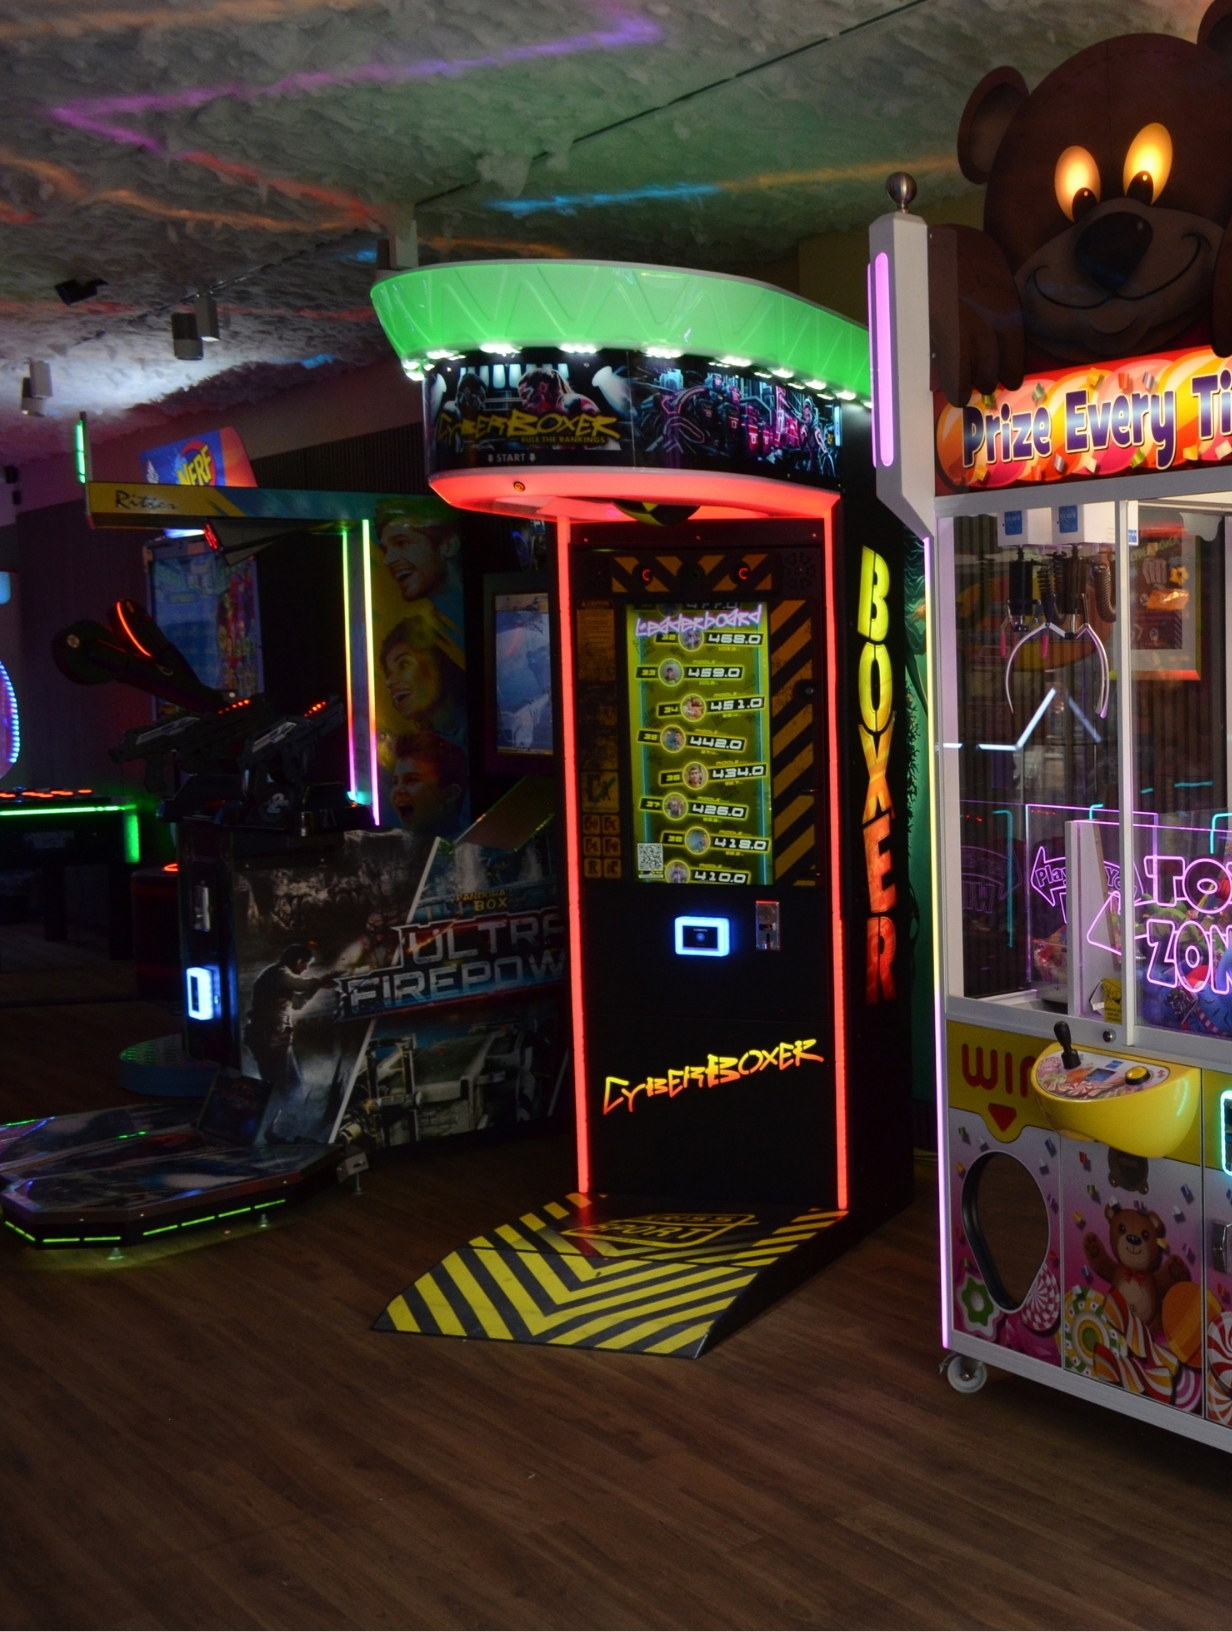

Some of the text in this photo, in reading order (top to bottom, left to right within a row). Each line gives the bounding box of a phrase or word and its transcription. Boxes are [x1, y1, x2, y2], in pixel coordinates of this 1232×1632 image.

[962, 402, 1052, 468] Prize
[1064, 389, 1177, 470] Every
[177, 444, 212, 486] NERF
[496, 453, 526, 463] START
[708, 634, 762, 645] 468.0
[687, 667, 741, 678] 459.0
[710, 697, 763, 711] 451.0
[689, 736, 743, 750] 442.0
[712, 765, 765, 779] 434.0
[857, 545, 898, 1004] BOXER
[691, 804, 745, 818] 426.0
[714, 837, 767, 851] 418.0
[694, 870, 747, 884] 410.0
[474, 898, 508, 912] BOX
